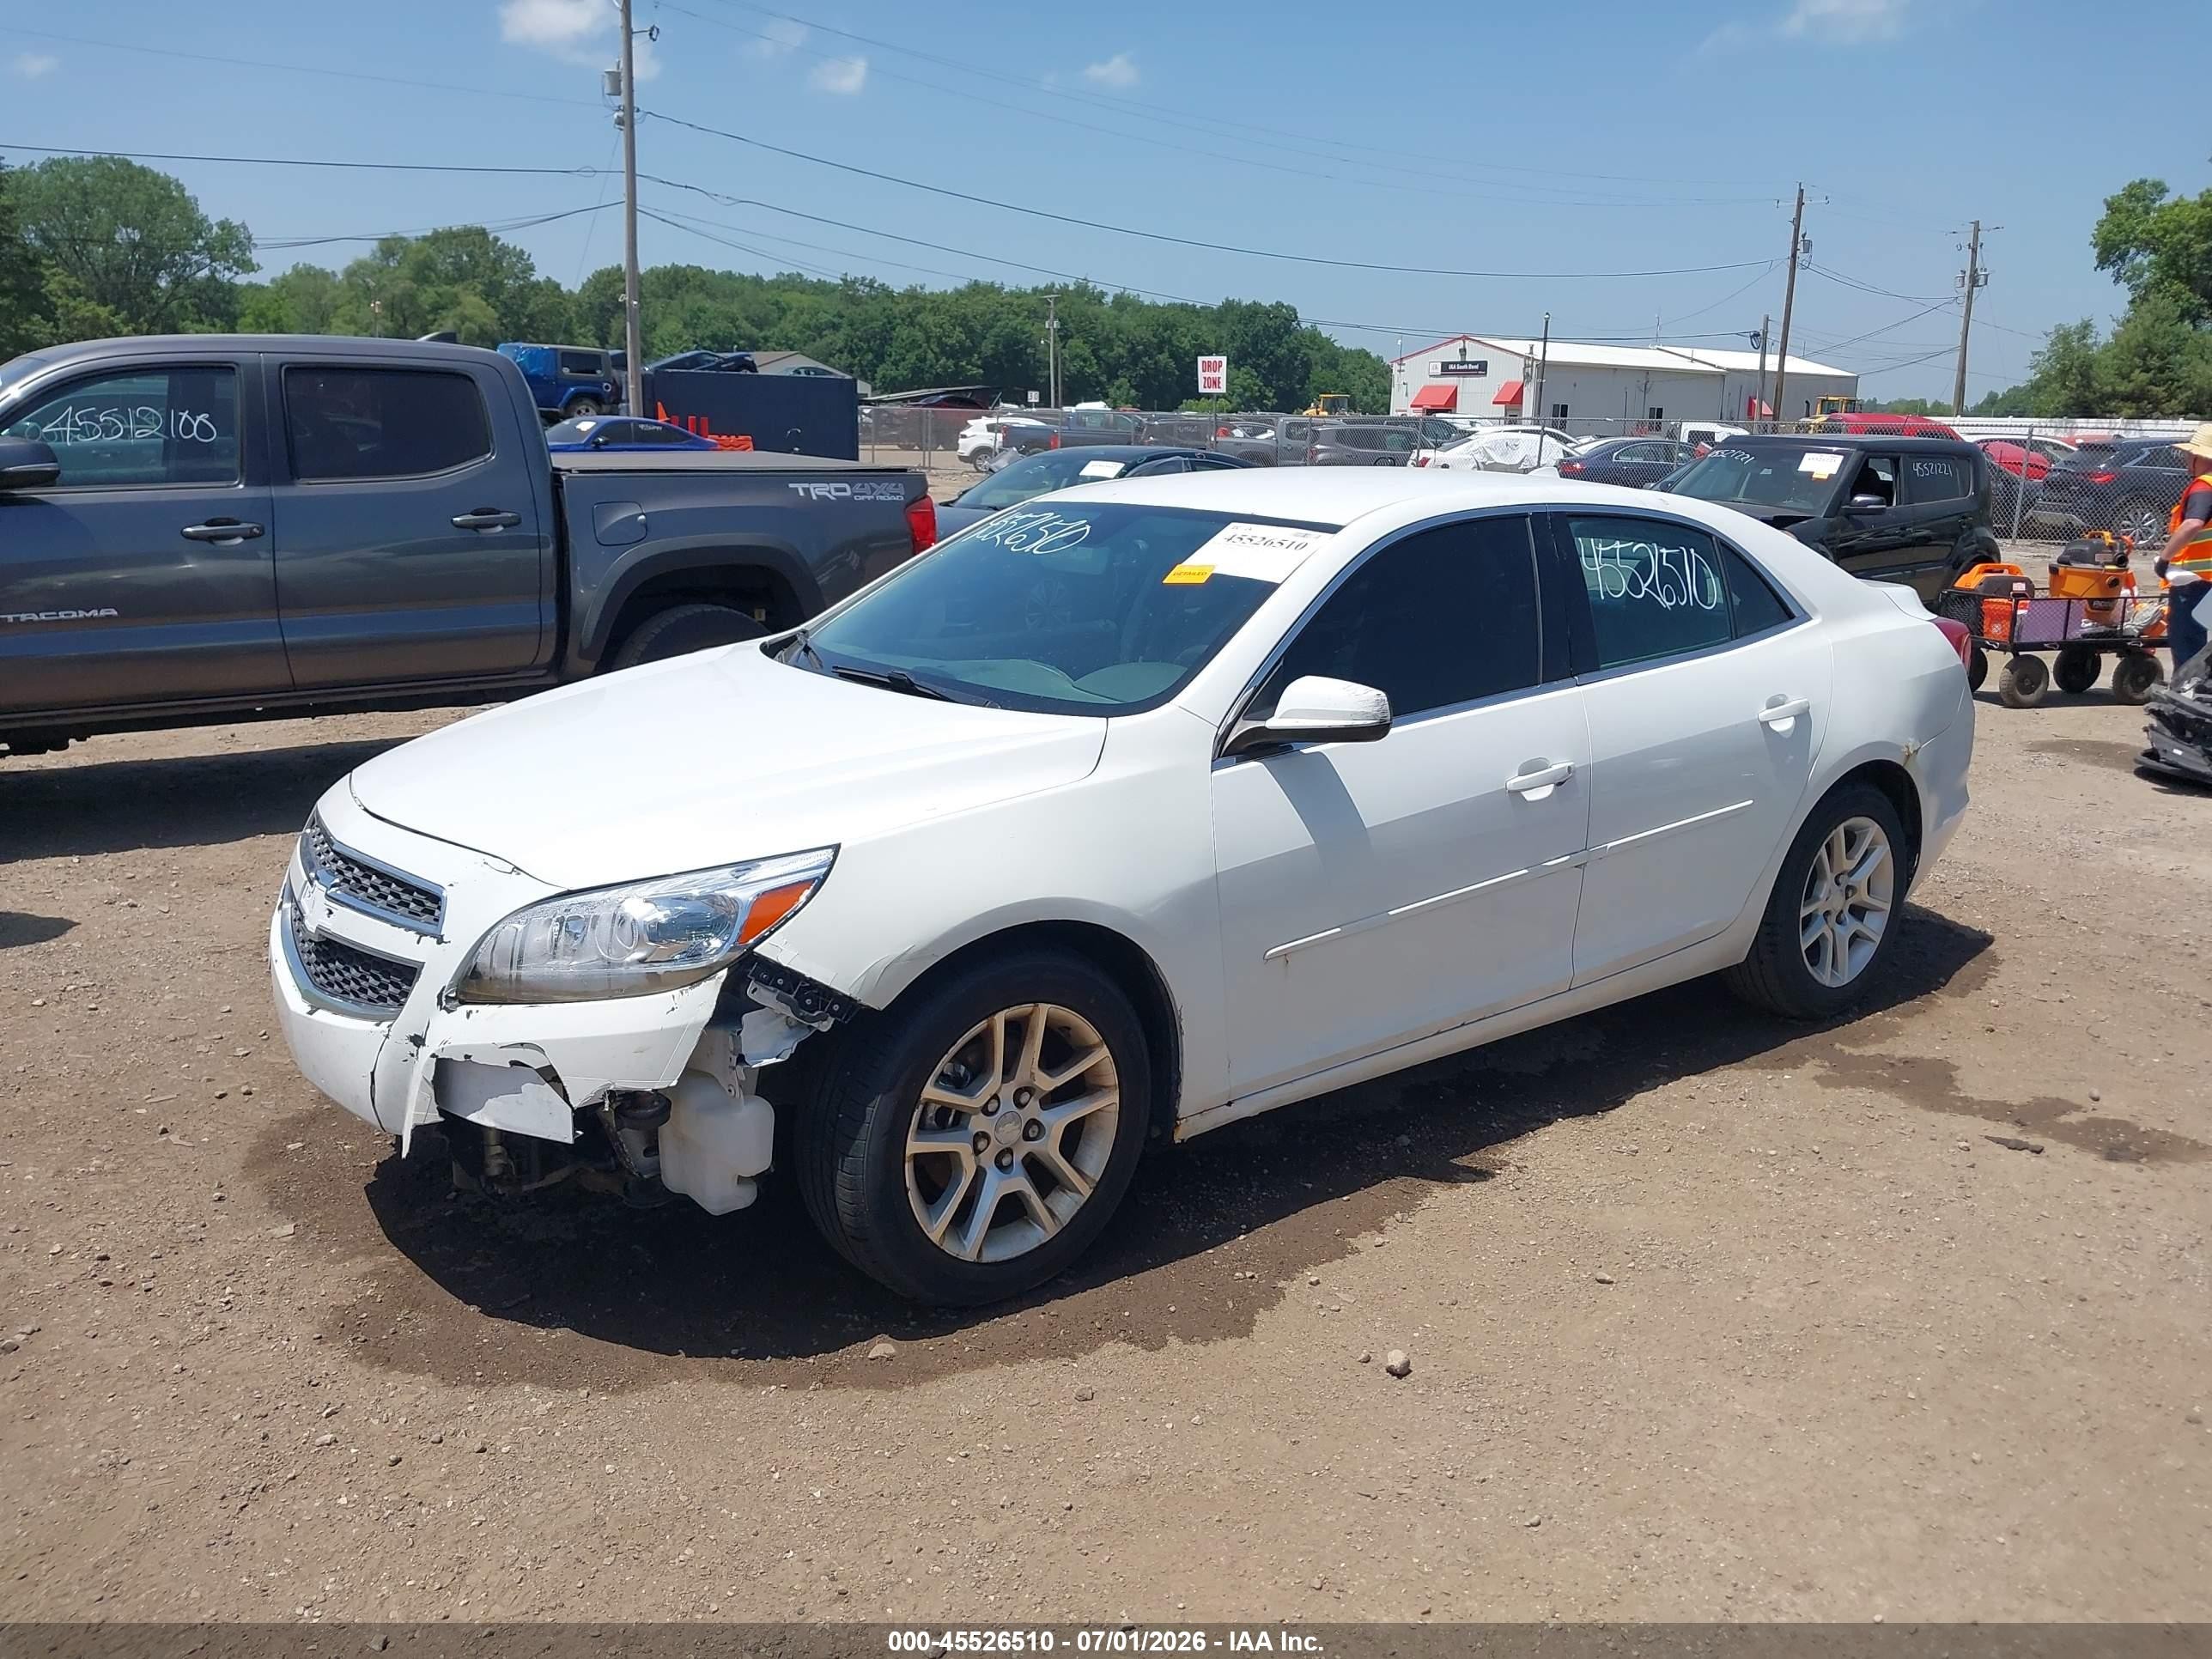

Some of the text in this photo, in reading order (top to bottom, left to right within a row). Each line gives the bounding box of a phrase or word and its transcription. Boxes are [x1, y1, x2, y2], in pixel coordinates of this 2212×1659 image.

[1201, 360, 1223, 373] DROP
[1202, 376, 1222, 389] ZONE
[1912, 462, 1953, 477] 45521221
[788, 483, 852, 501] TRD
[1224, 533, 1309, 550] 45526510
[1578, 537, 1717, 611] 45526510
[0, 608, 118, 623] TACOMA
